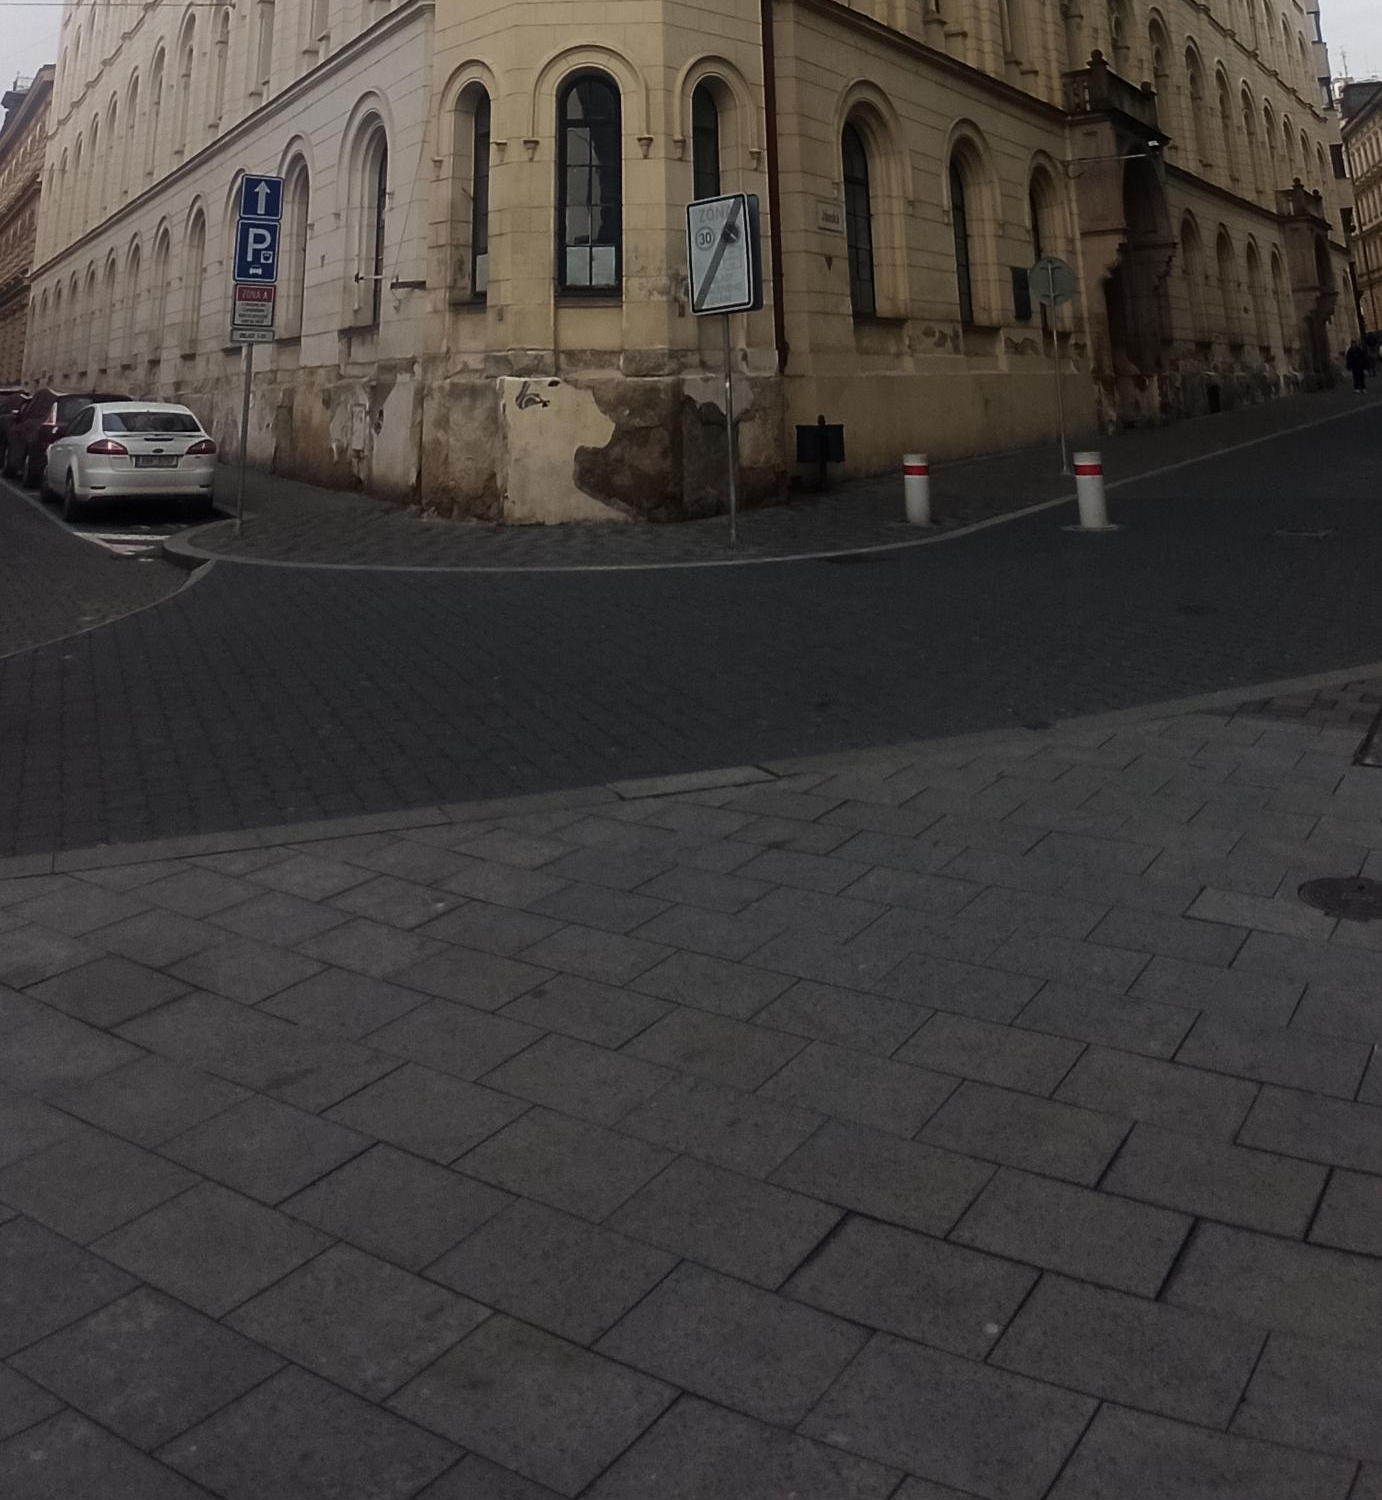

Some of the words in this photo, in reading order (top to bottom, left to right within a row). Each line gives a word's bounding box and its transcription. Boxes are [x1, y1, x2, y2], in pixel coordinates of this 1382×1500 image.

[247, 228, 271, 262] P
[699, 232, 712, 246] 30
[262, 290, 269, 300] A
